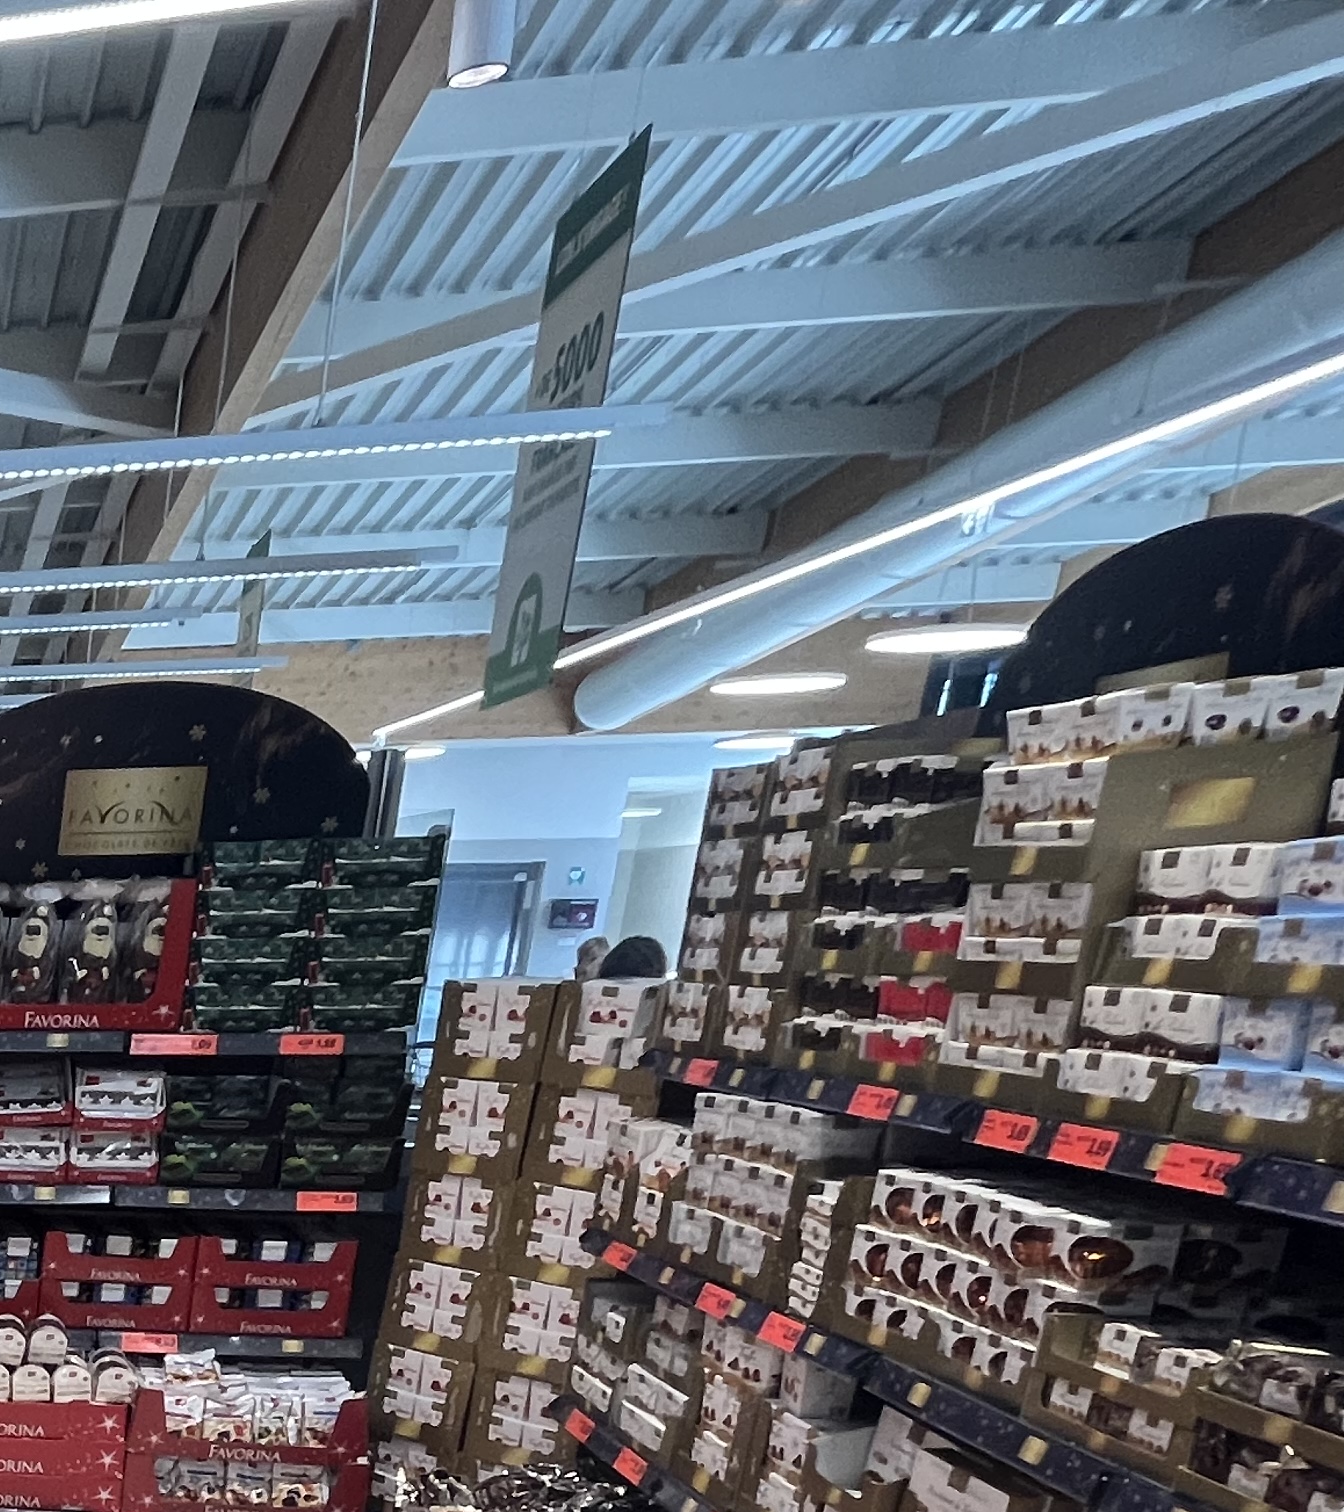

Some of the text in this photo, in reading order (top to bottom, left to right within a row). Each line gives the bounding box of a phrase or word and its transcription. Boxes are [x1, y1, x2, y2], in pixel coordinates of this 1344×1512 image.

[68, 801, 193, 826] FAVORINA
[24, 1011, 100, 1029] FAVORINA
[86, 1315, 136, 1329] FAVORINA
[208, 1444, 282, 1463] FAVORINA
